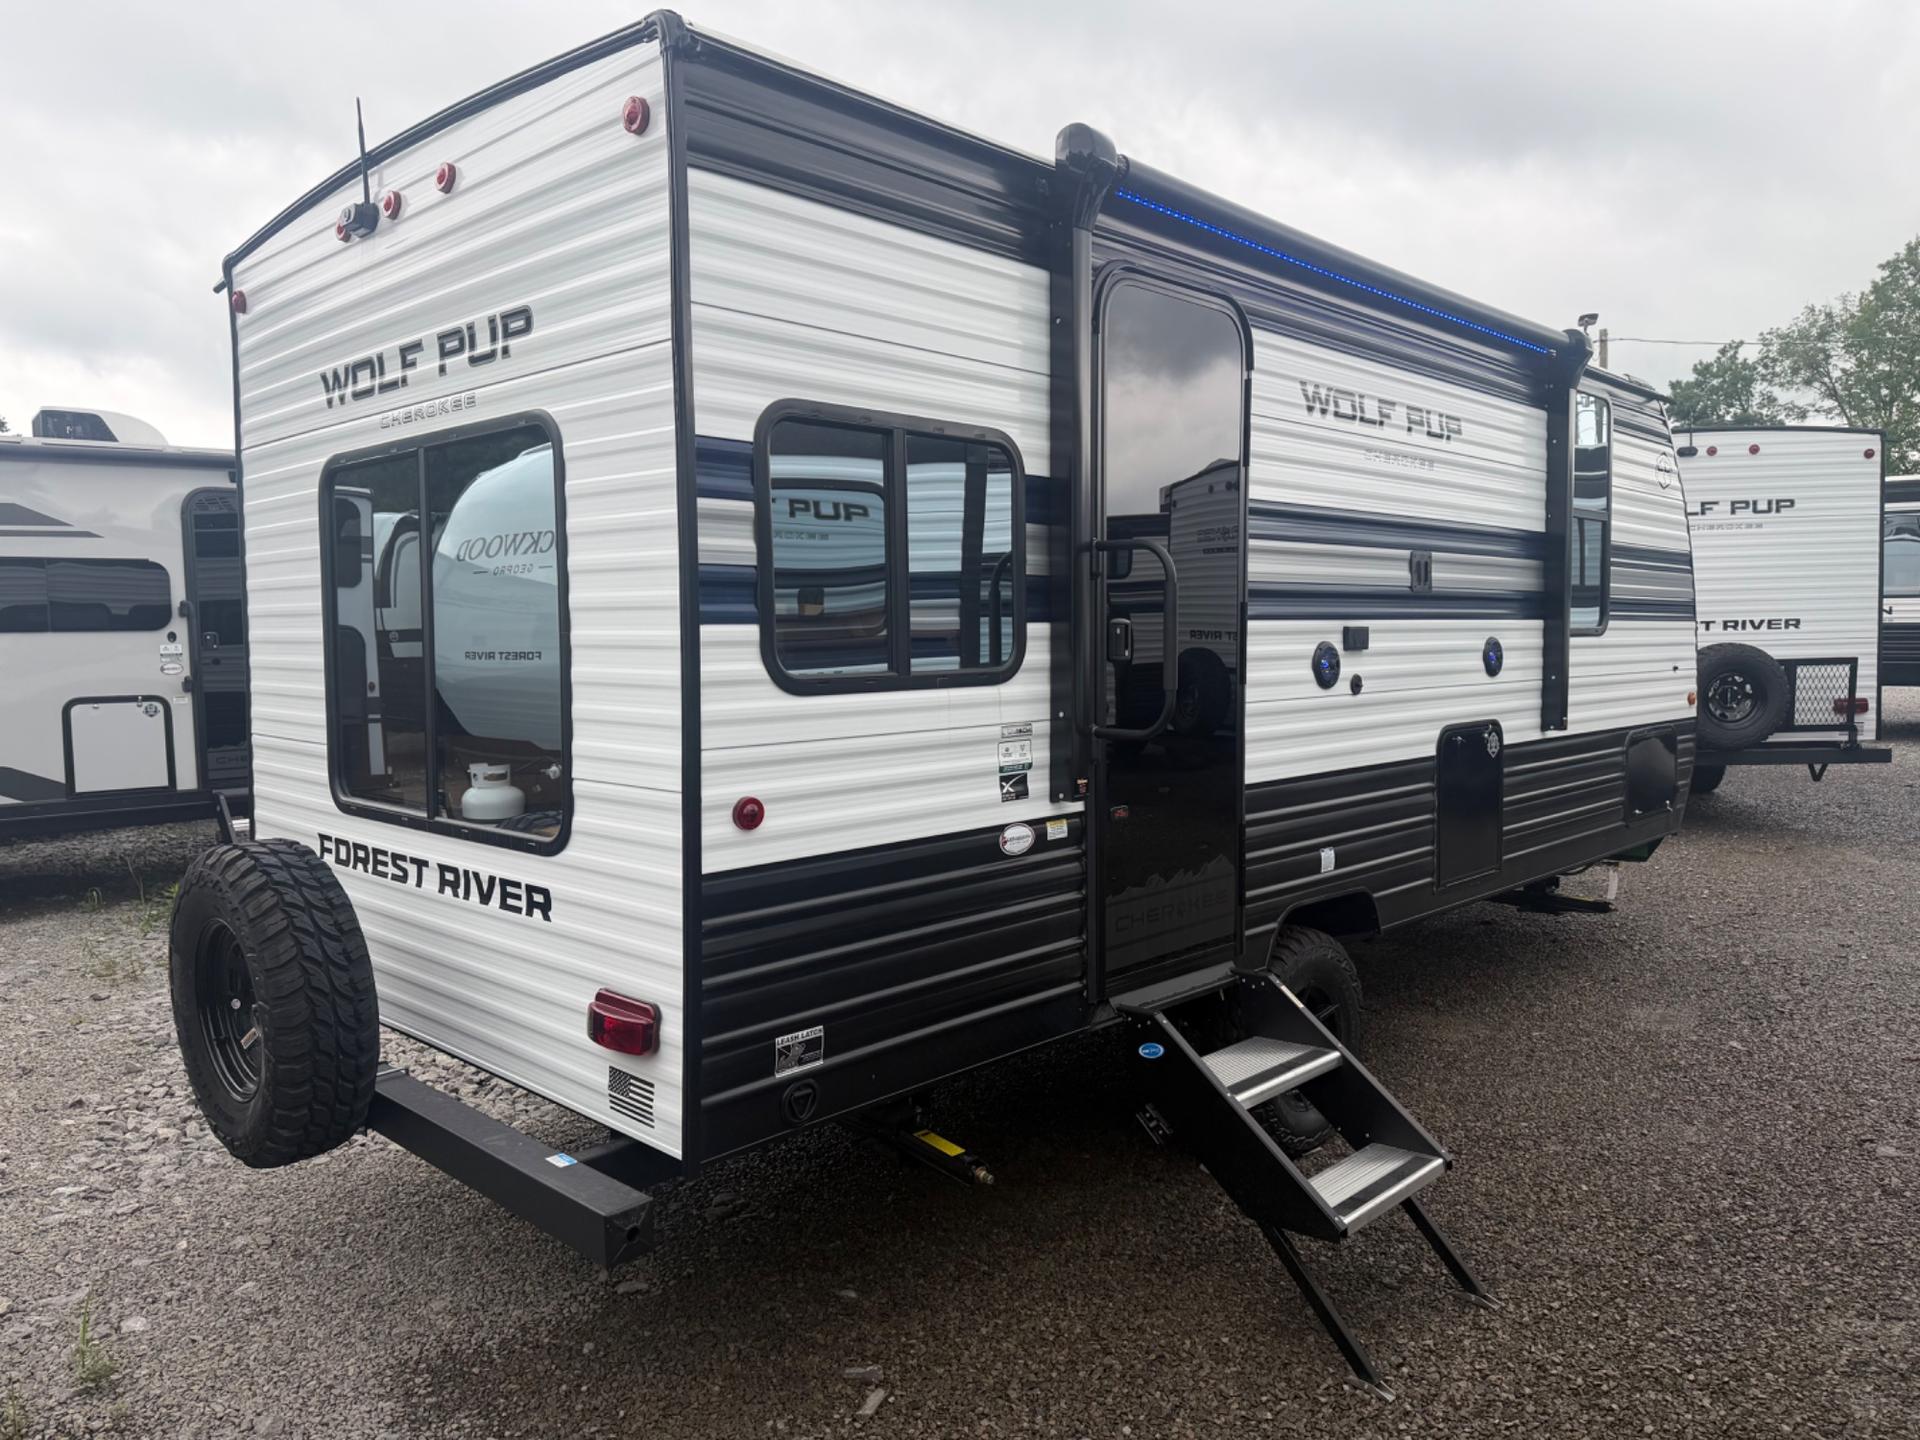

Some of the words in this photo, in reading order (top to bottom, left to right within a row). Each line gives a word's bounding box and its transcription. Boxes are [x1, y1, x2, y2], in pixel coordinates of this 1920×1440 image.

[320, 338, 424, 409] WOLF
[436, 304, 534, 377] PUP
[380, 393, 476, 429] CHEROKEE
[1299, 380, 1397, 427] WOLF
[1406, 405, 1463, 442] PUP
[788, 498, 870, 522] PUP
[1730, 498, 1796, 516] PUP
[1722, 617, 1802, 632] RIVER
[317, 832, 430, 888] FOREST
[437, 862, 552, 923] RIVER
[777, 1034, 800, 1046] LEASH
